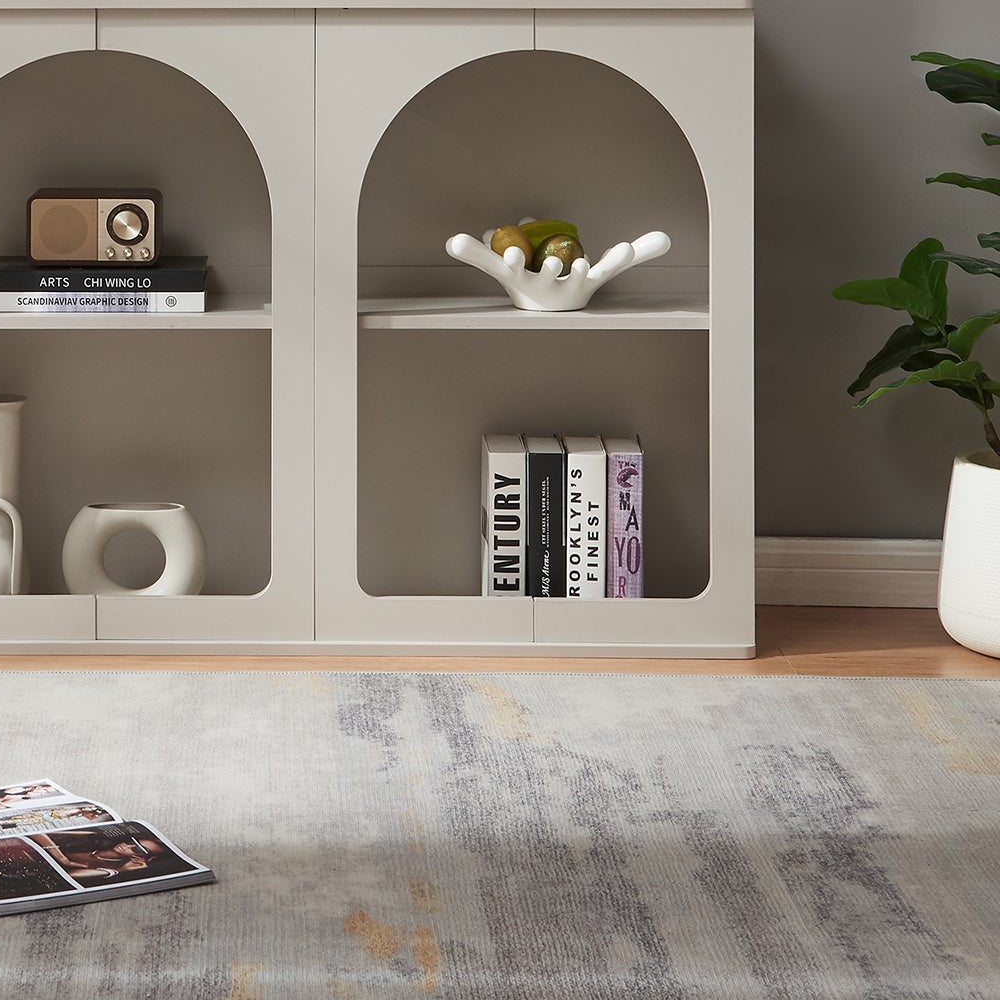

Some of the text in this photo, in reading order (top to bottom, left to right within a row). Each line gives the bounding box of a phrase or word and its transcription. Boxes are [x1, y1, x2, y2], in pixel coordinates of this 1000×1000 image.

[40, 277, 152, 288] ARTS CHI WING LO
[80, 297, 115, 306] GRAPHIC
[118, 297, 149, 306] DESIGN
[493, 473, 521, 597] ENTURY
[569, 468, 583, 597] ROOKLYN'S
[587, 501, 600, 582] FINEST
